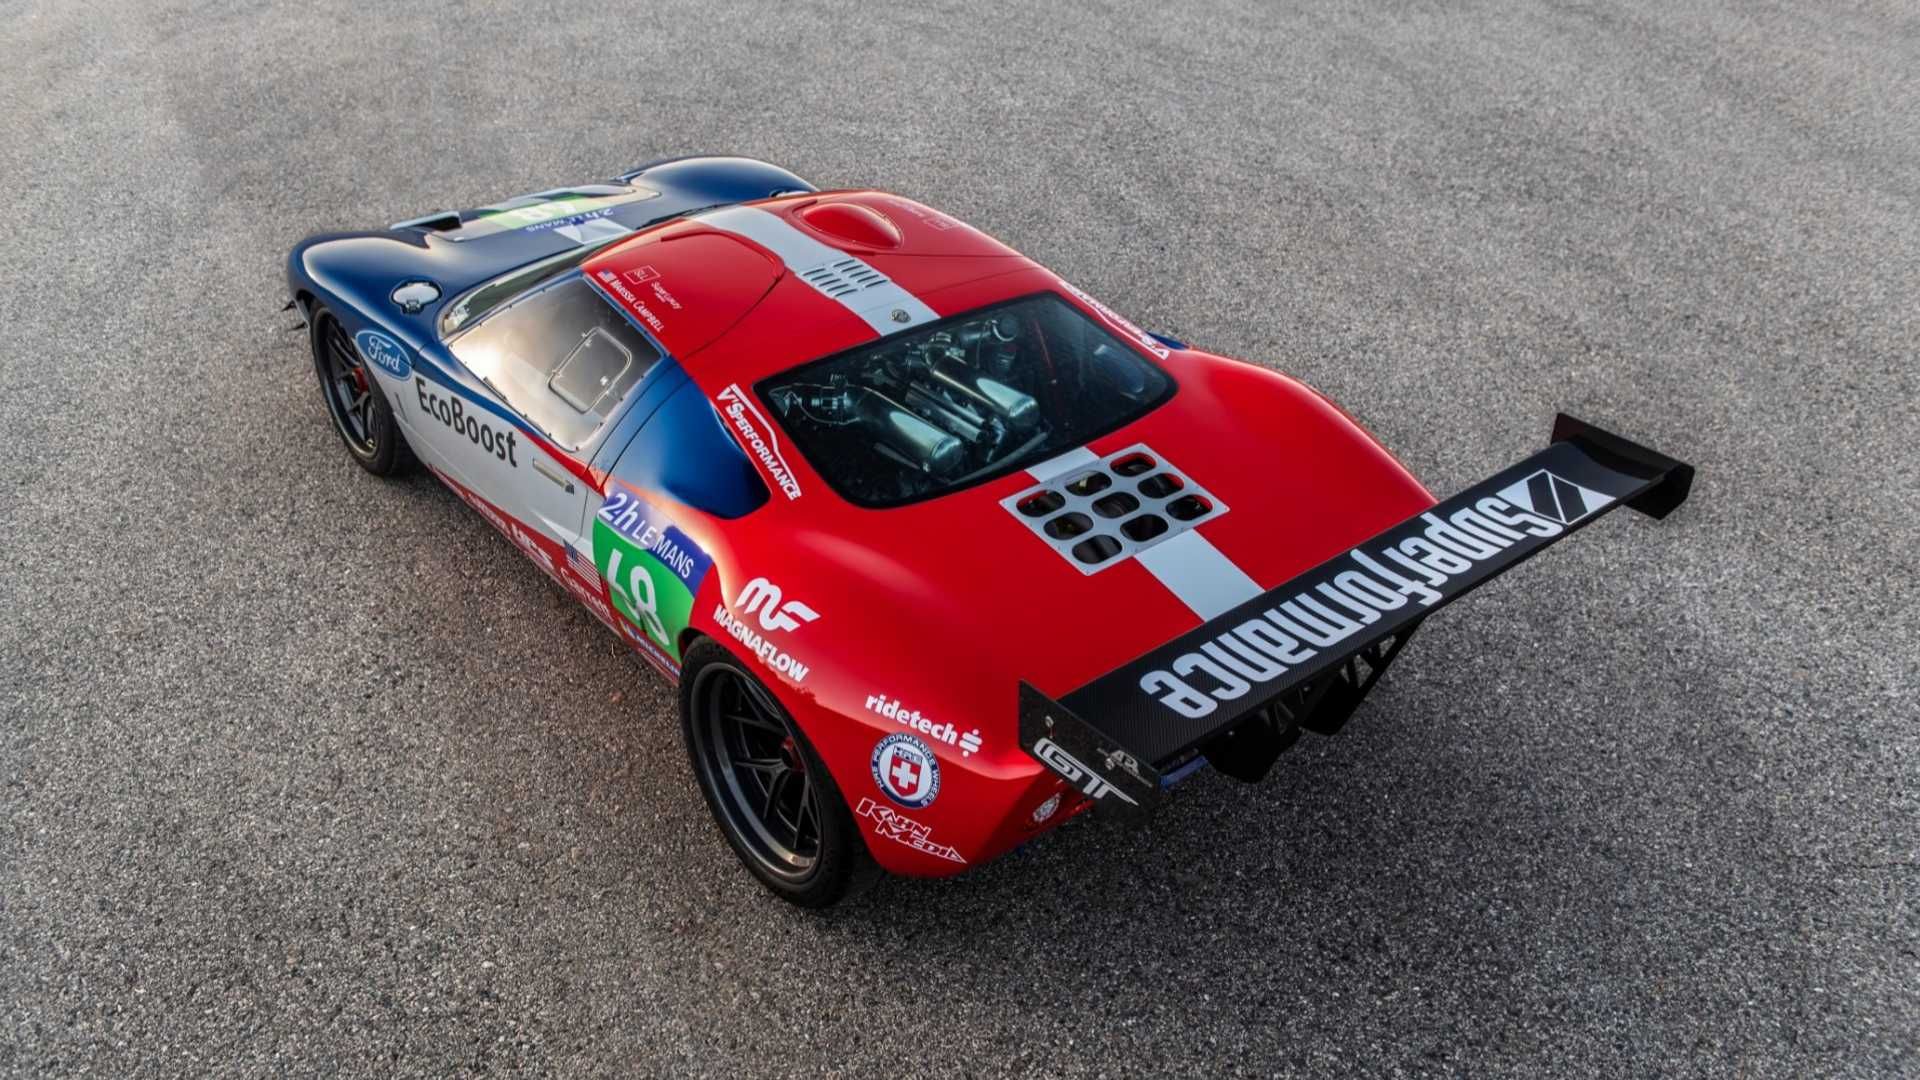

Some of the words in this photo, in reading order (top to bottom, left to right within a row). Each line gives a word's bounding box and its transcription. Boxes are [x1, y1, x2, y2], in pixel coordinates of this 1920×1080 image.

[368, 335, 401, 372] Ford
[415, 377, 518, 467] EcoBoost
[633, 520, 657, 545] LE
[653, 533, 694, 579] MANS
[713, 603, 810, 682] MAGNAFLOW
[1139, 497, 1565, 719] Superformance
[865, 694, 958, 745] ridetech
